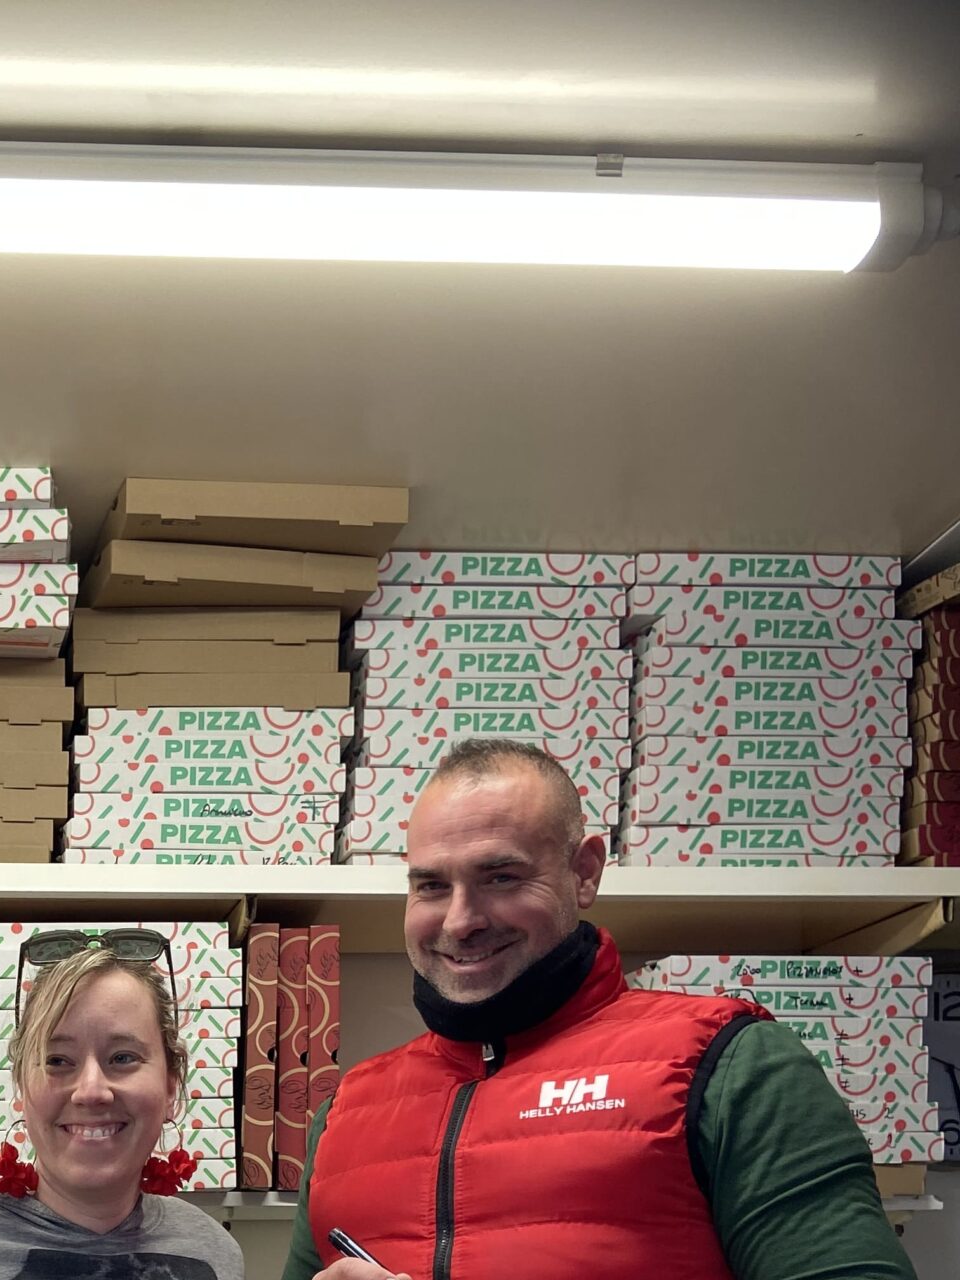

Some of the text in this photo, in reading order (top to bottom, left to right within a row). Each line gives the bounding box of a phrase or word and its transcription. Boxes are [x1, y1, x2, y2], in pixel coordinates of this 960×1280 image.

[461, 555, 544, 576] PIZZA
[730, 559, 810, 577] PIZZA
[452, 589, 534, 610] PIZZA
[723, 591, 803, 611] PIZZA
[444, 622, 526, 644] PIZZA
[754, 619, 832, 640] PIZZA
[459, 652, 540, 673] PIZZA
[741, 651, 821, 670] PIZZA
[455, 682, 537, 702] PIZZA
[735, 680, 815, 702] PIZZA
[178, 710, 261, 732] PIZZA
[453, 712, 536, 733] PIZZA
[734, 710, 816, 731] PIZZA
[164, 738, 247, 760] PIZZA
[738, 740, 819, 760] PIZZA
[169, 765, 253, 787] PIZZA
[729, 769, 810, 790] PIZZA
[163, 797, 244, 818] PIZZA
[727, 798, 808, 818] PIZZA
[160, 823, 242, 846] PIZZA
[720, 828, 805, 849] PIZZA
[759, 960, 841, 980] PIZZA
[754, 991, 836, 1011] PIZZA
[519, 1099, 626, 1120] HELLY HANSEN
